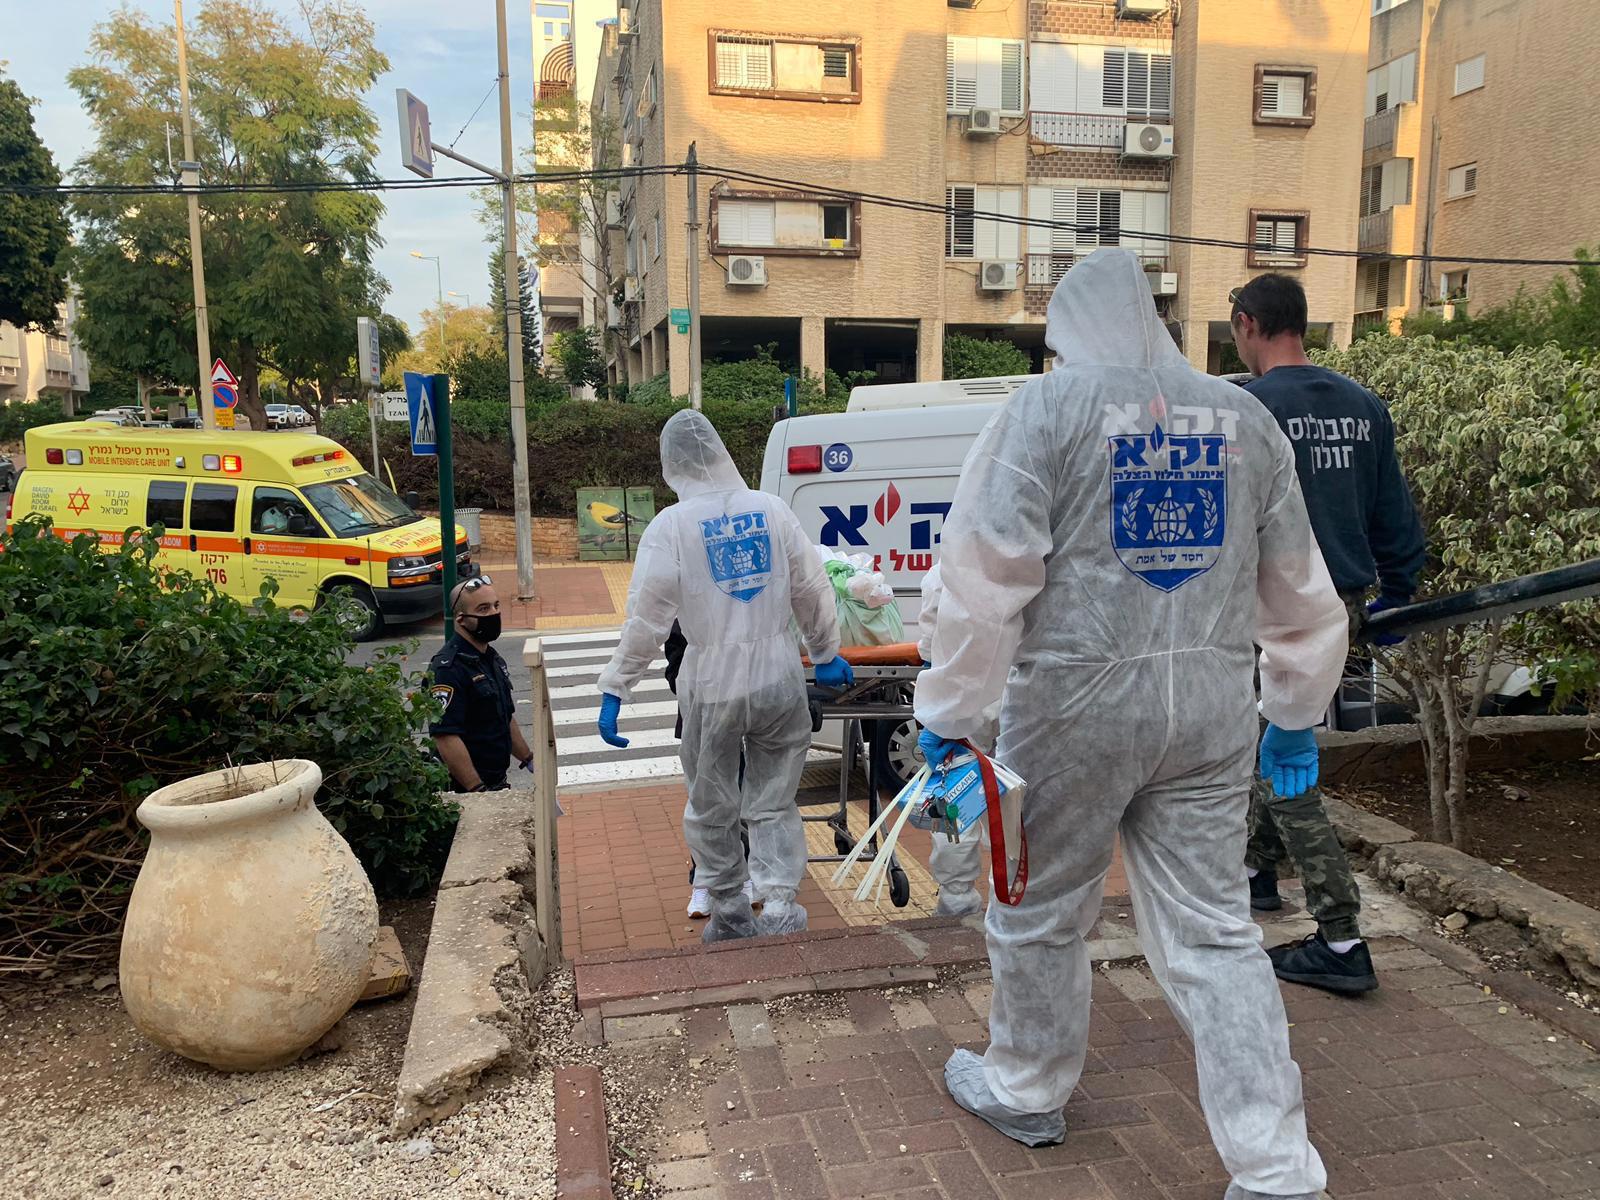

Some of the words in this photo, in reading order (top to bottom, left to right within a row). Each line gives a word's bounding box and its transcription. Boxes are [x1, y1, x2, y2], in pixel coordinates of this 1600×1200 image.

[1287, 413, 1371, 442] אמבולנס
[88, 445, 113, 455] נמרץ
[115, 444, 142, 456] טיפול
[145, 446, 170, 456] ניידת
[88, 456, 110, 465] MOBILE
[111, 457, 139, 466] INTENSIVE
[140, 458, 157, 467] CARE
[157, 459, 170, 467] UNIT
[828, 450, 849, 465] 36
[1112, 469, 1152, 480] הצלה
[1154, 468, 1184, 480] חילוץ
[1187, 470, 1225, 479] איתור
[111, 498, 129, 507] אדום
[100, 505, 128, 515] בישראל
[200, 553, 229, 565] ירקון
[890, 549, 932, 571] של
[1135, 554, 1155, 564] אמת
[1160, 549, 1177, 563] של
[1181, 553, 1204, 562] חסד
[206, 568, 227, 585] 176
